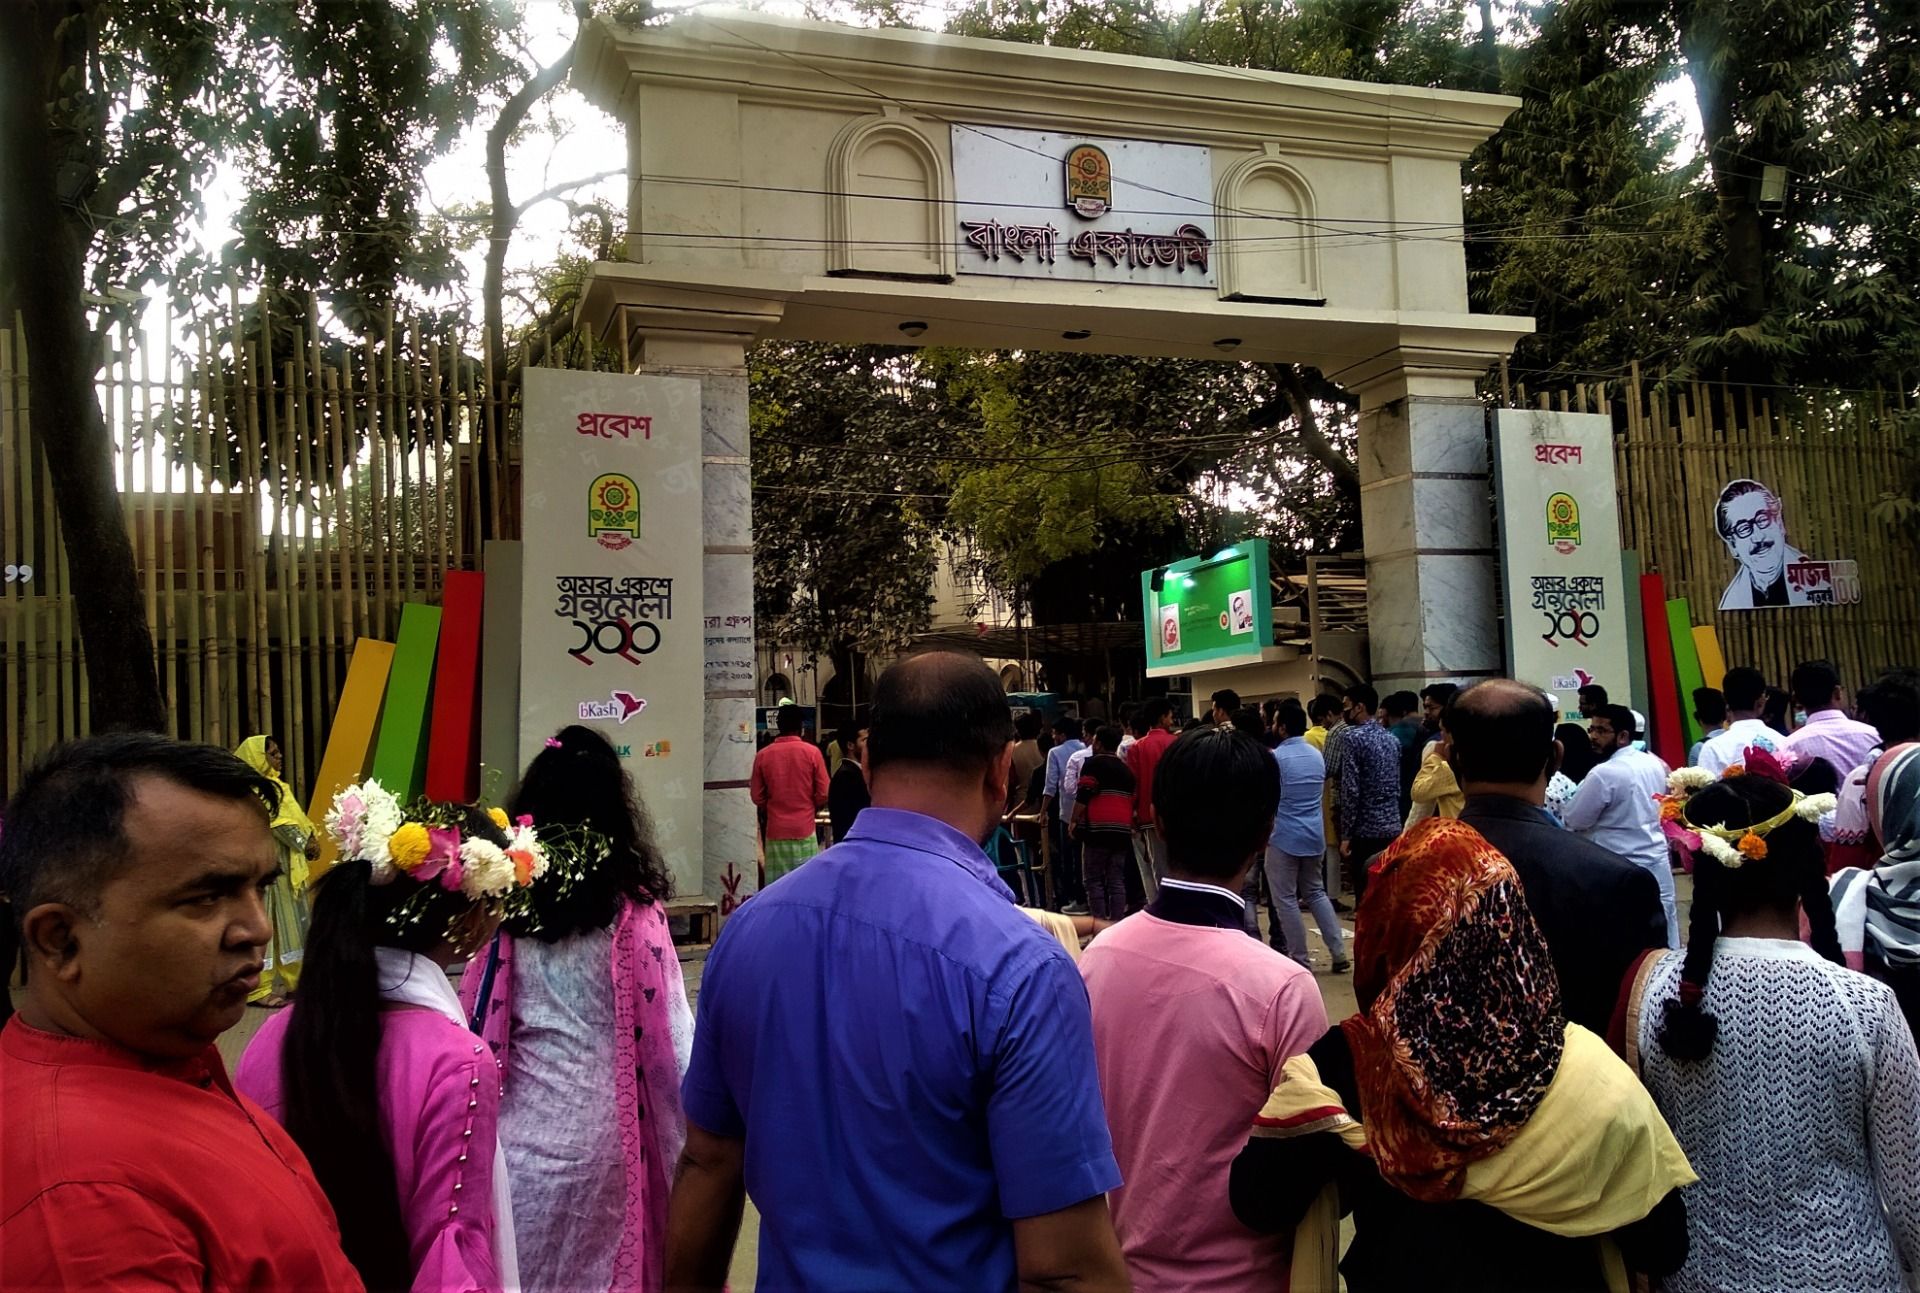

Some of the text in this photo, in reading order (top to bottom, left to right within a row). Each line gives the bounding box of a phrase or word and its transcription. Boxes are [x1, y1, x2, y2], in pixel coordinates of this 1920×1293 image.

[961, 217, 1212, 273] বাংলা একাডেমি
[576, 413, 652, 440] প্রবেশ
[1535, 444, 1582, 464] প্রবেশ
[1531, 577, 1604, 594] অমর একুশে
[1787, 557, 1831, 592] মুজিব
[556, 576, 673, 601] অমর একুশে
[555, 594, 672, 626] গ্রন্থমেলা
[1532, 591, 1604, 615] গ্রন্থমেলা
[1542, 609, 1600, 647] ২০২০
[568, 618, 661, 666] ২০২০
[1554, 678, 1578, 689] bKash
[580, 703, 618, 718] bKash
